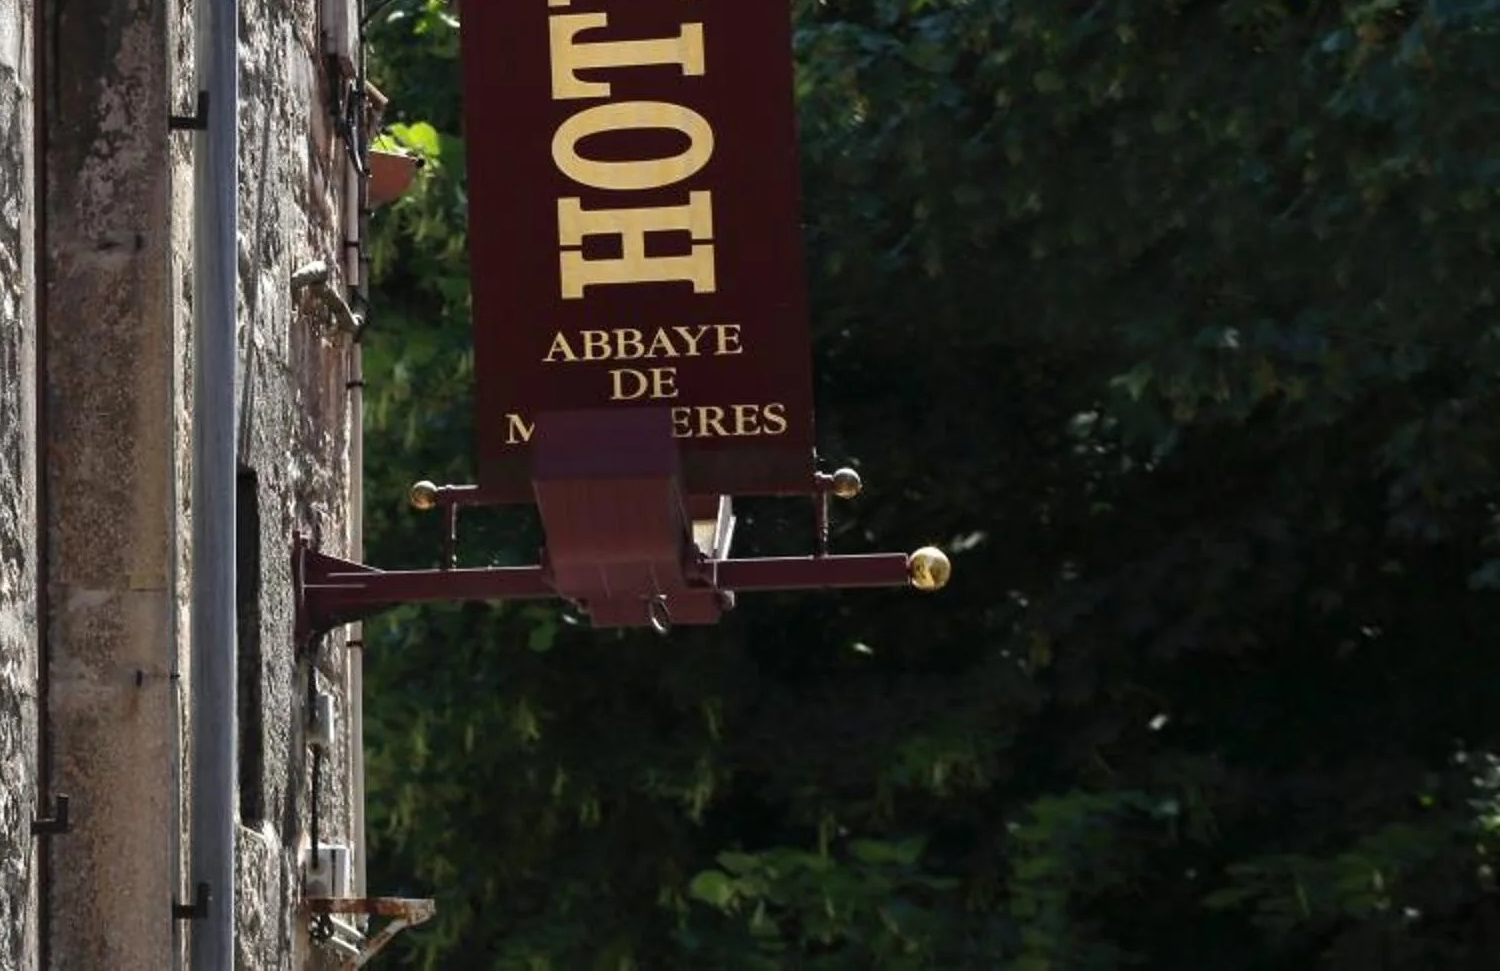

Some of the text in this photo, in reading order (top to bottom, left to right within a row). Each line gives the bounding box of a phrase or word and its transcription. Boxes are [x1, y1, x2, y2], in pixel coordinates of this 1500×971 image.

[542, 324, 743, 362] ABBAYE
[610, 367, 678, 400] DE
[504, 403, 788, 444] MERES
